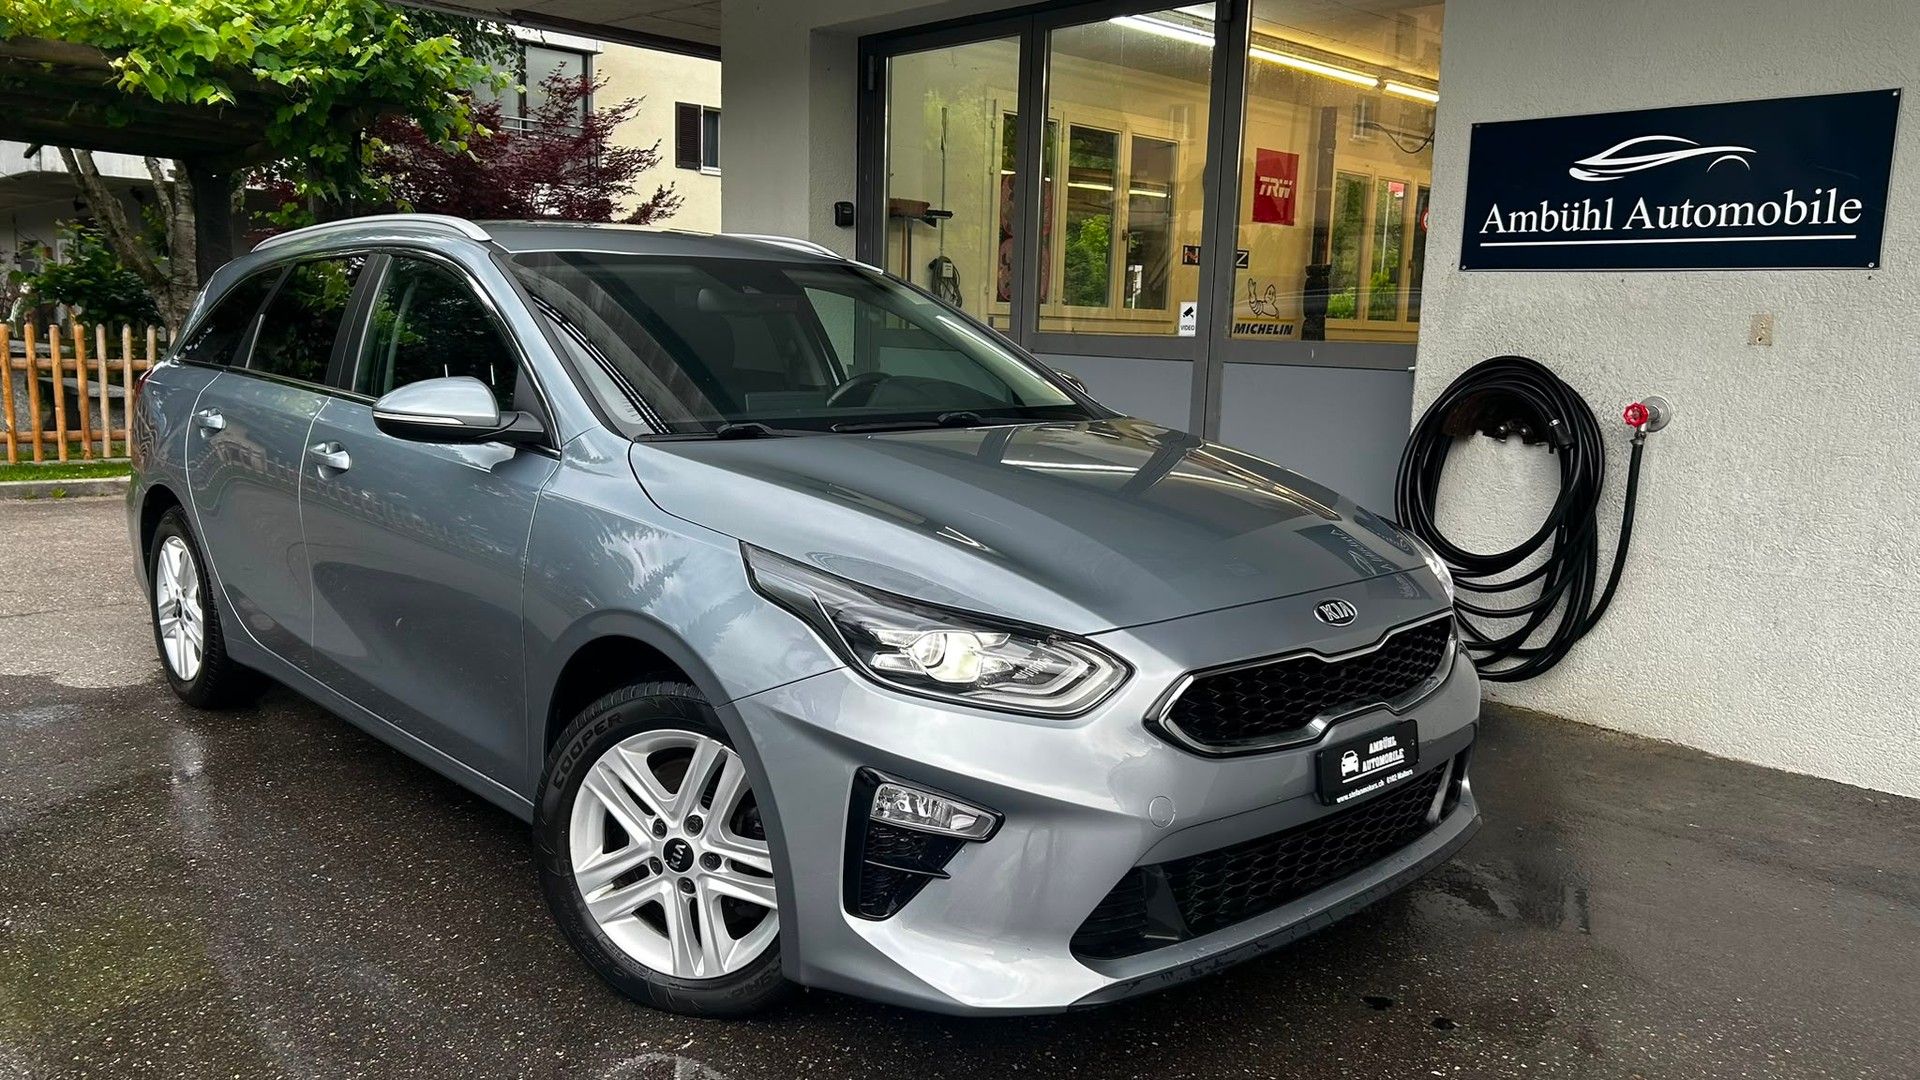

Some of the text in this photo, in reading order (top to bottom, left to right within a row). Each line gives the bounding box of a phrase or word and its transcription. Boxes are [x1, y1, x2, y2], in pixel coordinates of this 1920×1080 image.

[1259, 176, 1293, 198] TRW
[1479, 187, 1863, 234] Ambühl Automobile
[1233, 323, 1294, 335] MICHELIN
[1319, 601, 1354, 621] KIA
[553, 712, 623, 790] COOPER
[1368, 736, 1397, 754] AMBÜHL
[1362, 748, 1405, 772] AUTOMOBILE
[670, 844, 687, 869] KIA
